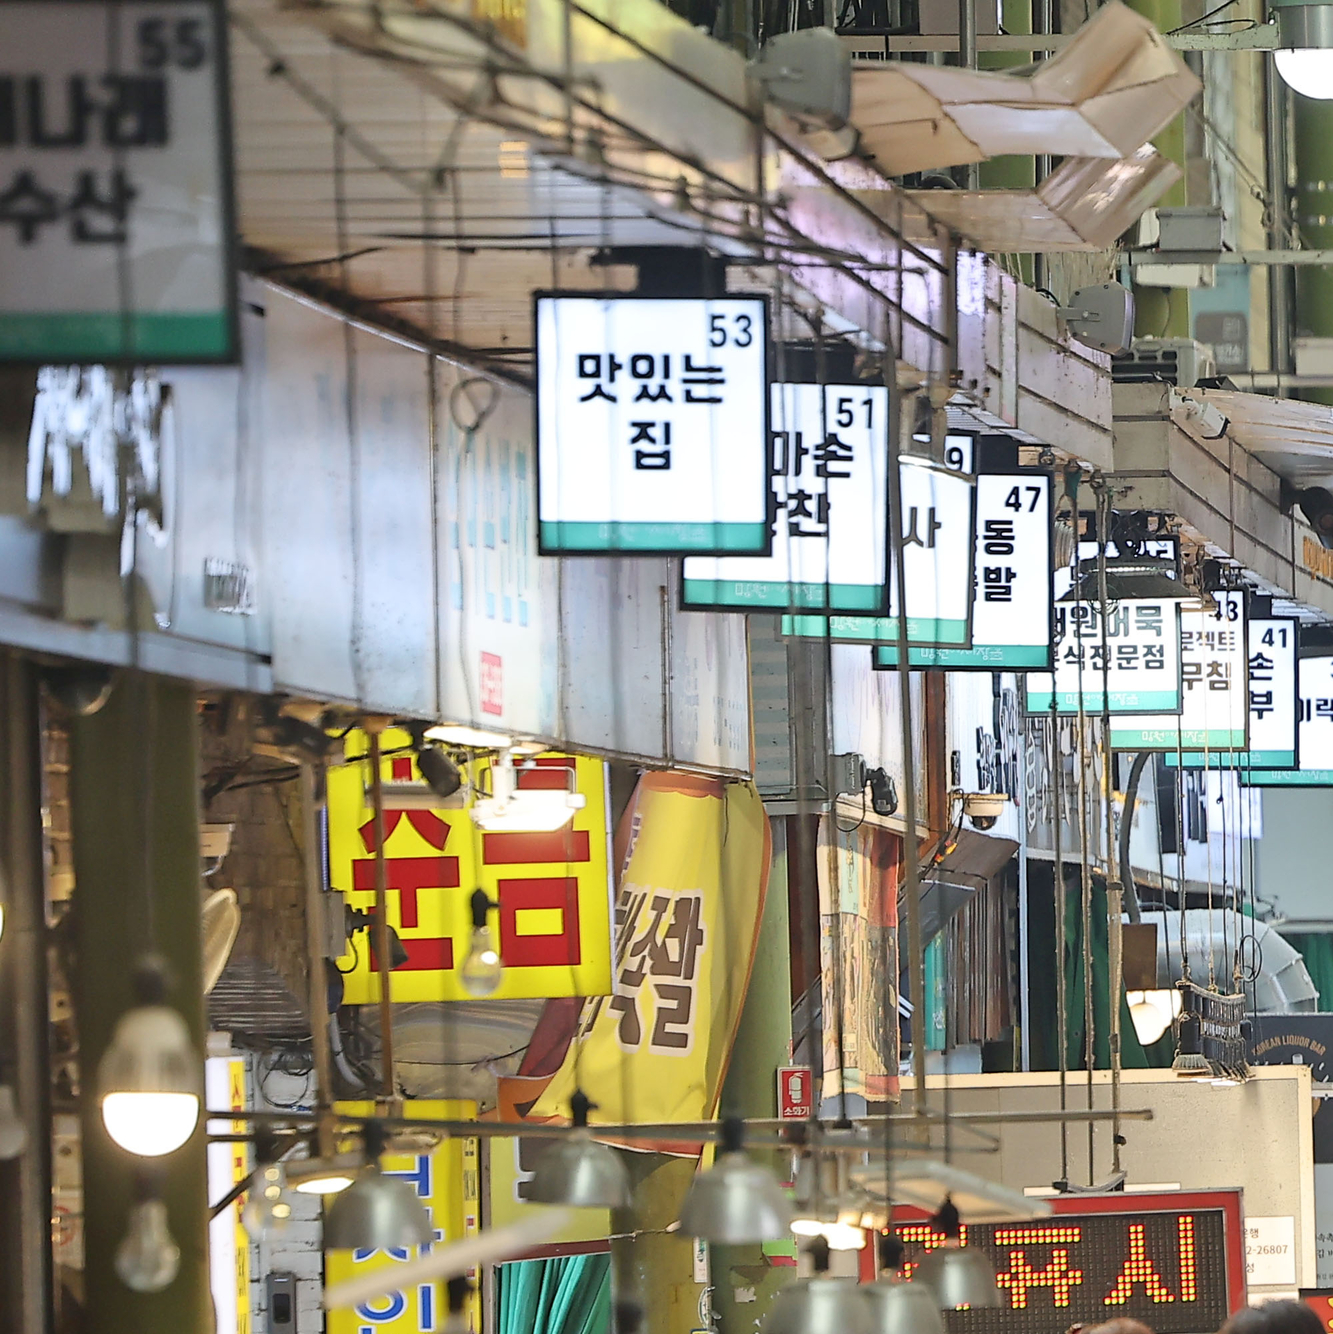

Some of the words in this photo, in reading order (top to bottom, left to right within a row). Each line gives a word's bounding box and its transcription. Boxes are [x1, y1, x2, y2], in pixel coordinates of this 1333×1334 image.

[137, 17, 206, 72] 55
[0, 170, 138, 245] 수산
[709, 314, 753, 349] 53
[577, 352, 726, 404] 맛있는
[836, 397, 874, 430] 51
[629, 420, 671, 471] 집
[1004, 485, 1042, 513] 47
[982, 518, 1016, 556] 동
[982, 566, 1018, 603] 발
[1260, 627, 1288, 649] 41
[1052, 643, 1165, 672] 식전문점
[352, 757, 591, 973] 순금
[1282, 1034, 1311, 1049] LIQUOR
[1309, 1039, 1327, 1057] BAR
[783, 1106, 811, 1117] 소화기
